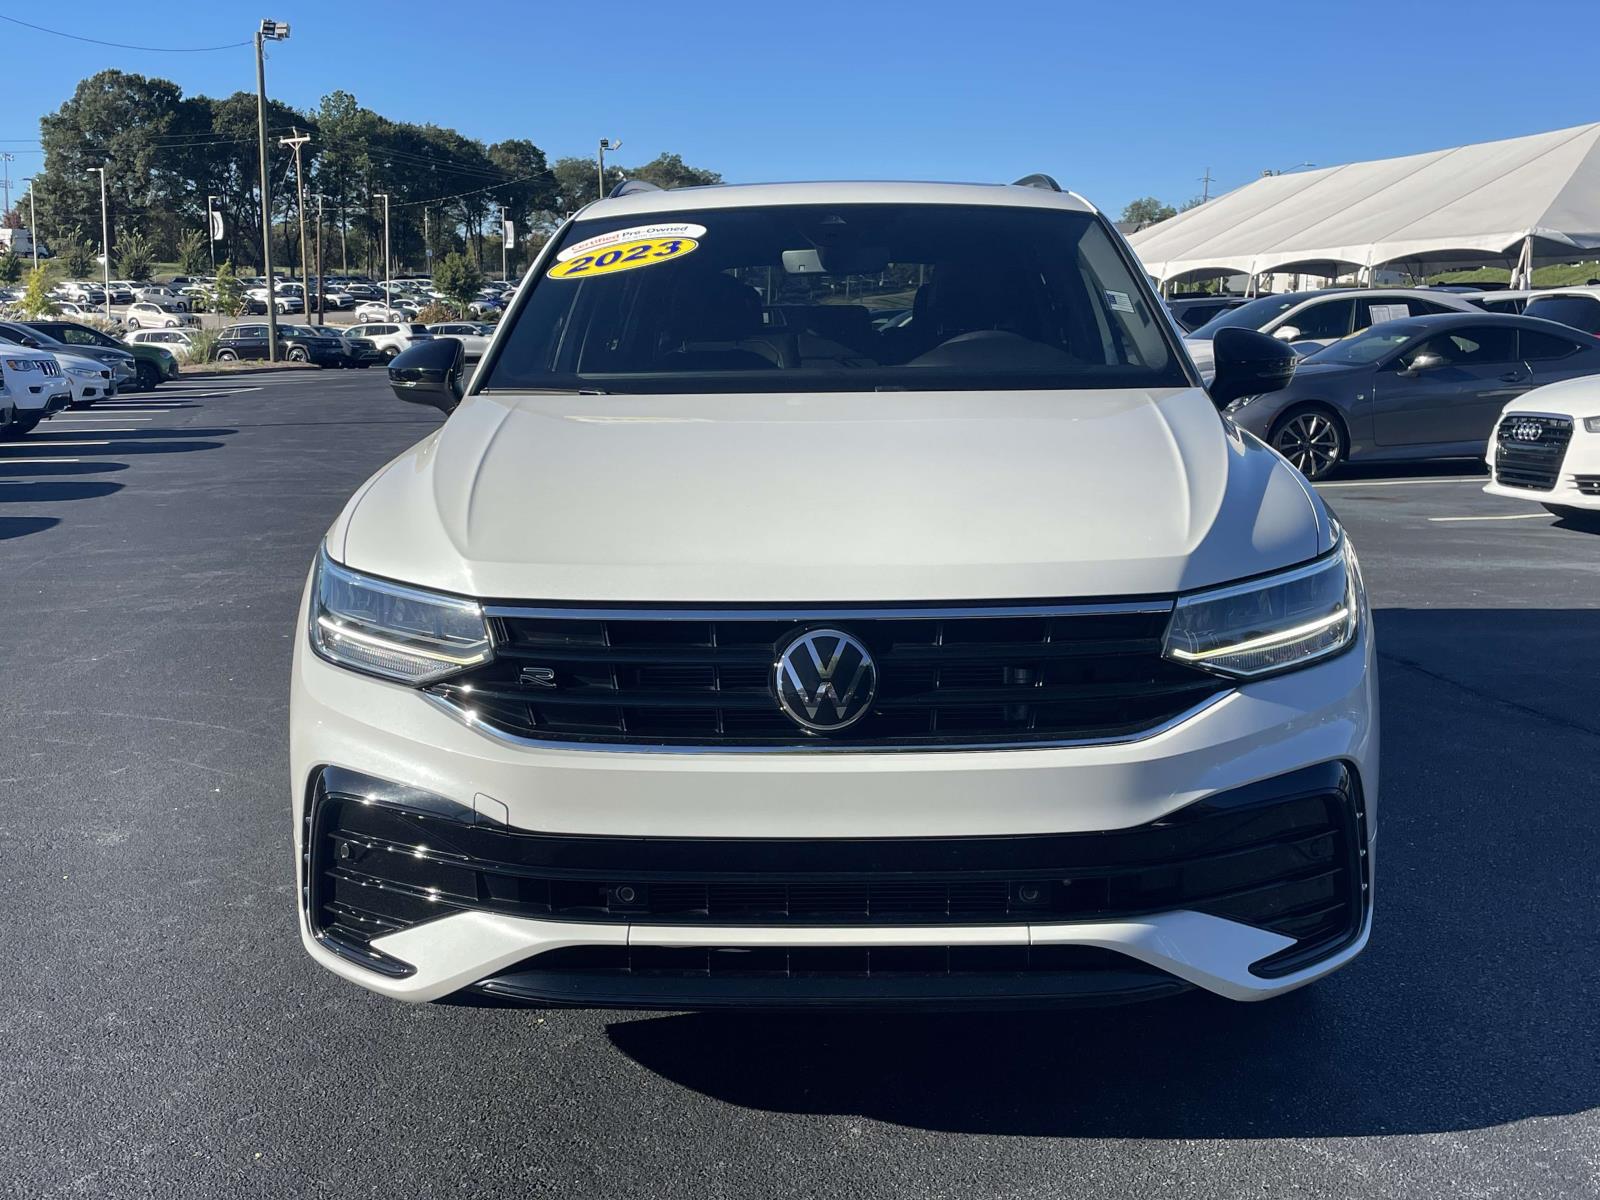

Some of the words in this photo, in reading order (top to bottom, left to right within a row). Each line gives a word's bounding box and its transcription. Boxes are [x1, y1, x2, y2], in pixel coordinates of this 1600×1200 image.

[571, 233, 619, 251] Certified
[622, 226, 688, 237] Pre-Owned
[563, 240, 682, 275] 2023
